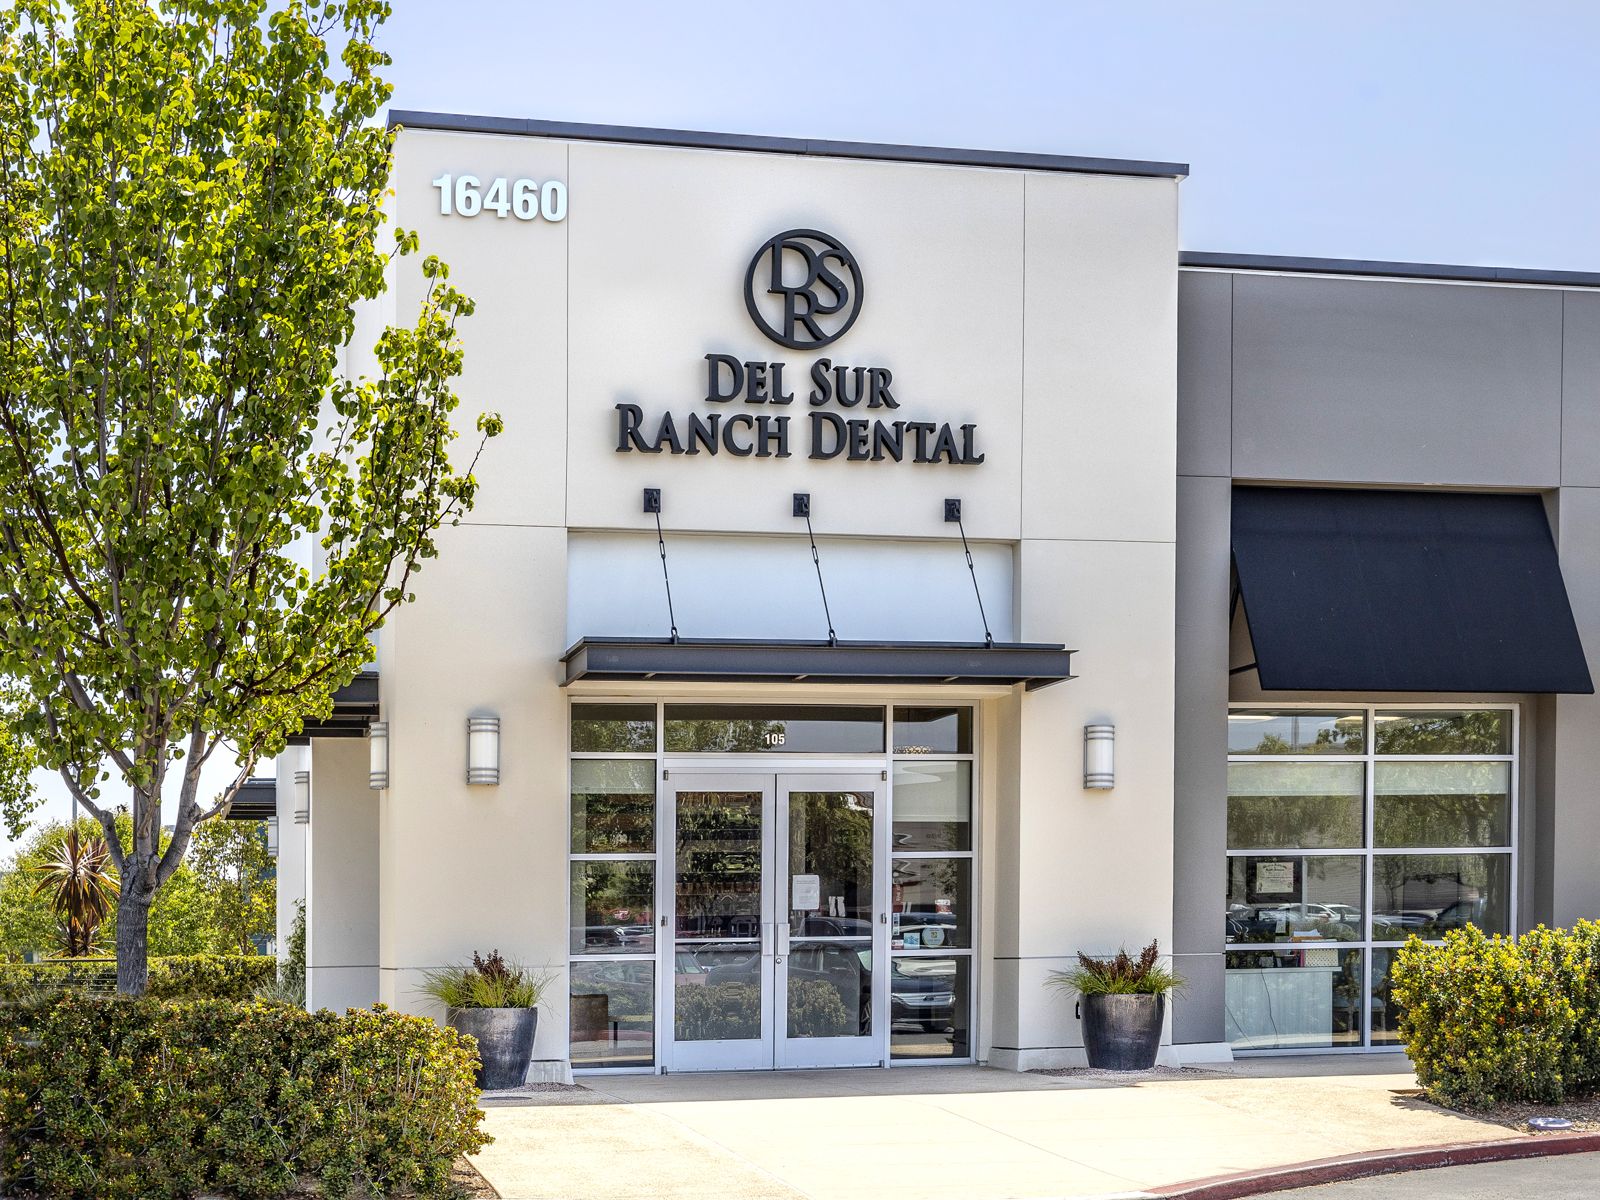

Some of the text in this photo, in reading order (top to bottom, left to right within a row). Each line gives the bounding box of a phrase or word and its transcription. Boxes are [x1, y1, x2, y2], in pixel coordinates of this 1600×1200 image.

[432, 173, 568, 222] 16460
[704, 353, 901, 409] DEL SUR
[615, 403, 985, 465] RANCH DENTAL
[765, 733, 785, 745] 105
